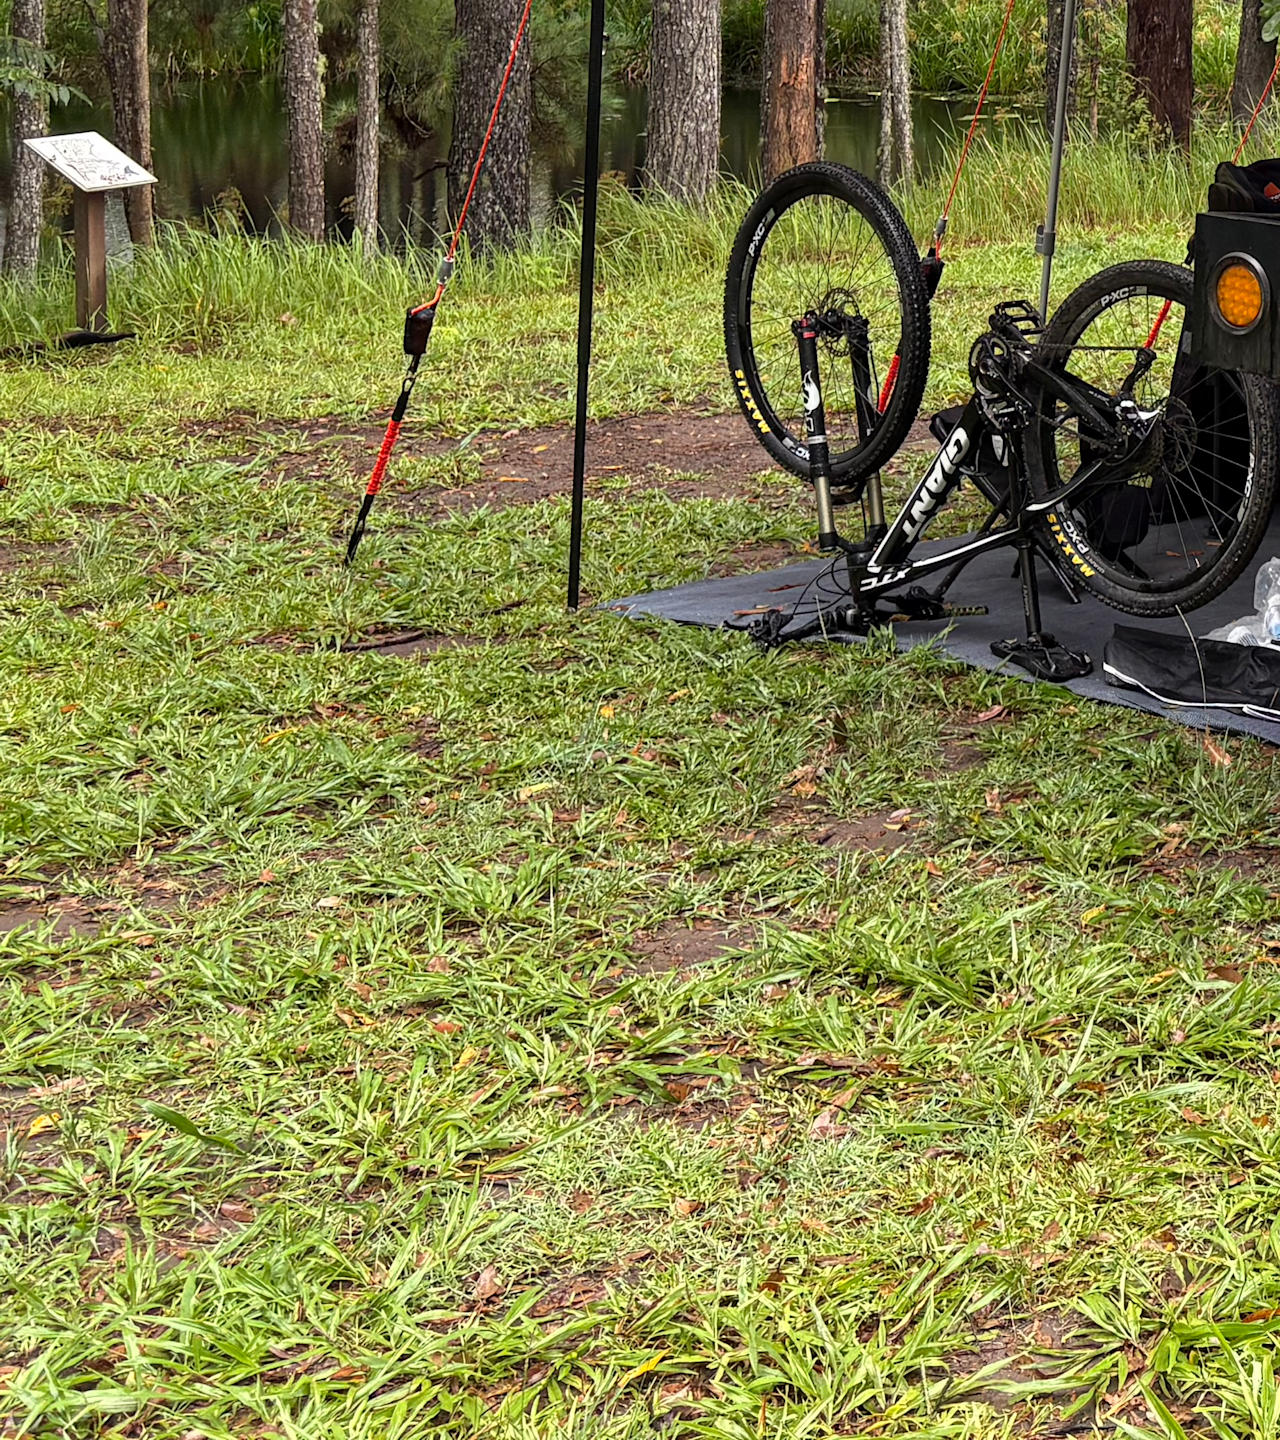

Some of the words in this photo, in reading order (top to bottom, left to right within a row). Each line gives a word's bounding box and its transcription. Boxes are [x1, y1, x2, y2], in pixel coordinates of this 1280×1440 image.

[734, 369, 770, 434] MAXXIS
[902, 427, 970, 543] GIANT
[1046, 513, 1096, 577] MAXXIS
